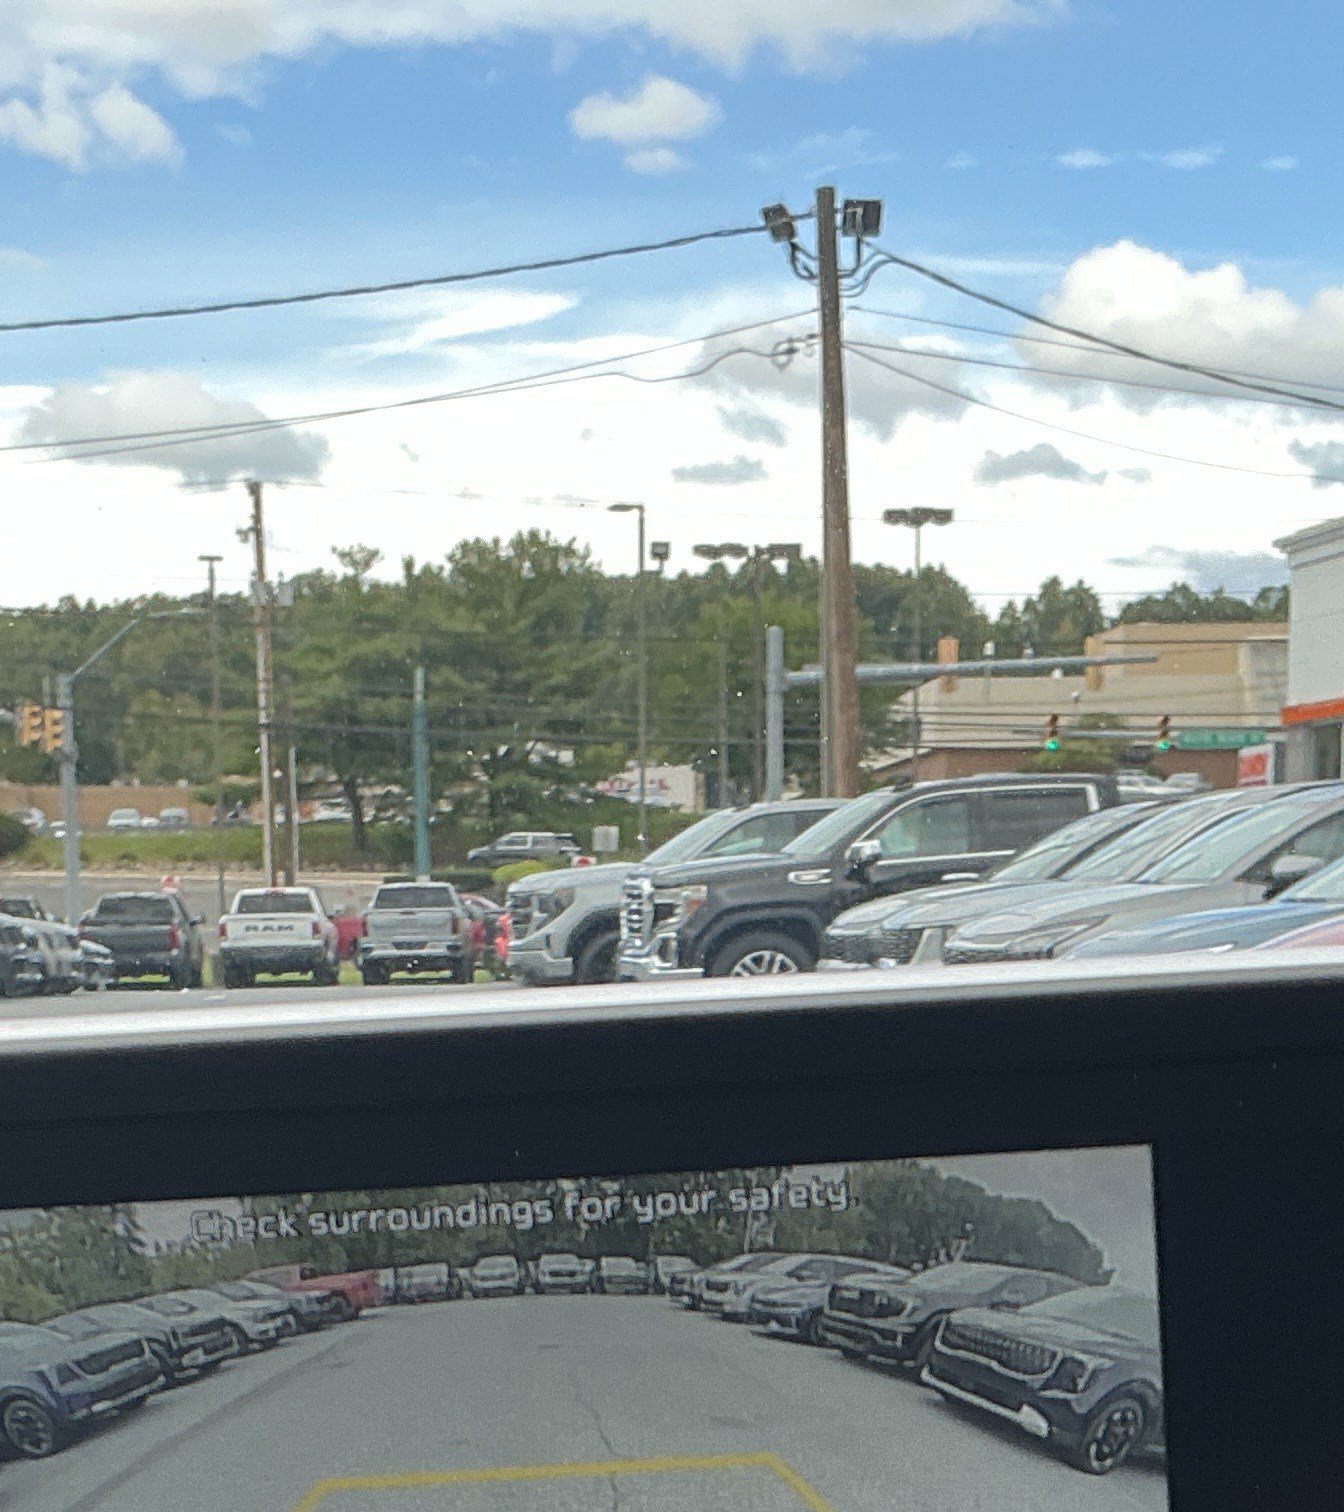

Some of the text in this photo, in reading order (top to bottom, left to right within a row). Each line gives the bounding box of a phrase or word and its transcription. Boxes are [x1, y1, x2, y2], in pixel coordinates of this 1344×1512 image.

[245, 924, 295, 932] RAM
[192, 1207, 300, 1241] Check
[308, 1196, 554, 1236] surroundings
[563, 1189, 622, 1222] for
[633, 1189, 717, 1224] your
